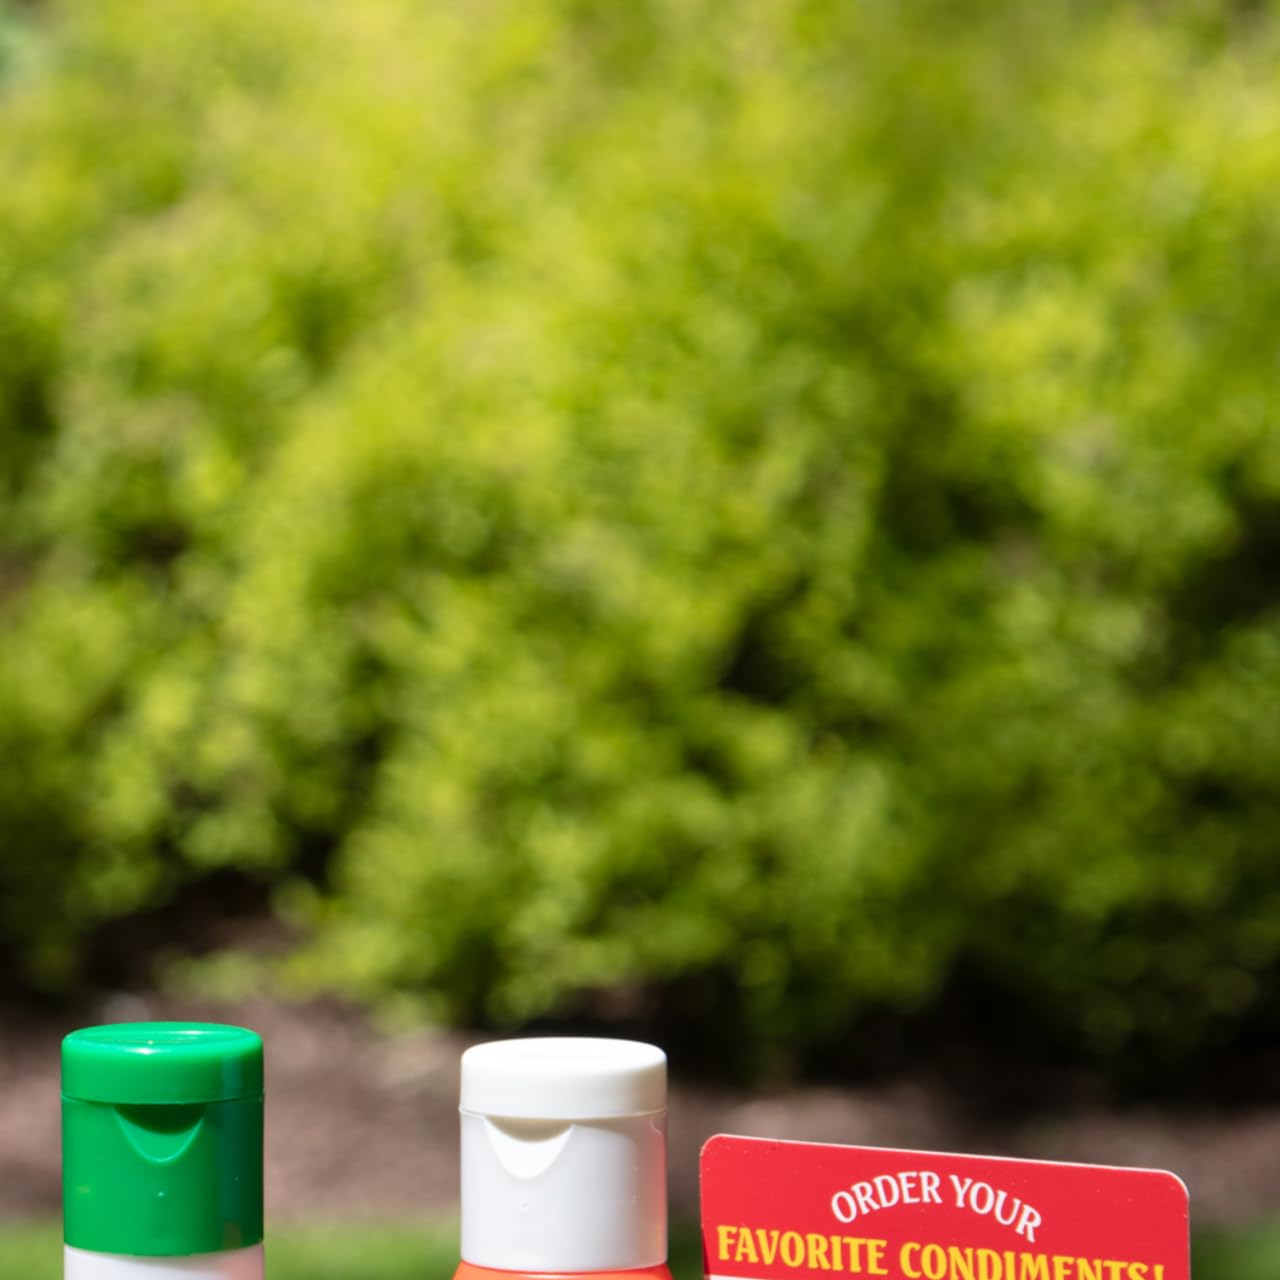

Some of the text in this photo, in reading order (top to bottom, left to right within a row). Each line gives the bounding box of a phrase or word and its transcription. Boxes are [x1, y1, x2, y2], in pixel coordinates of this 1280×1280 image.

[831, 1171, 1042, 1243] ORDER YOUR
[716, 1225, 888, 1275] FAVORITE
